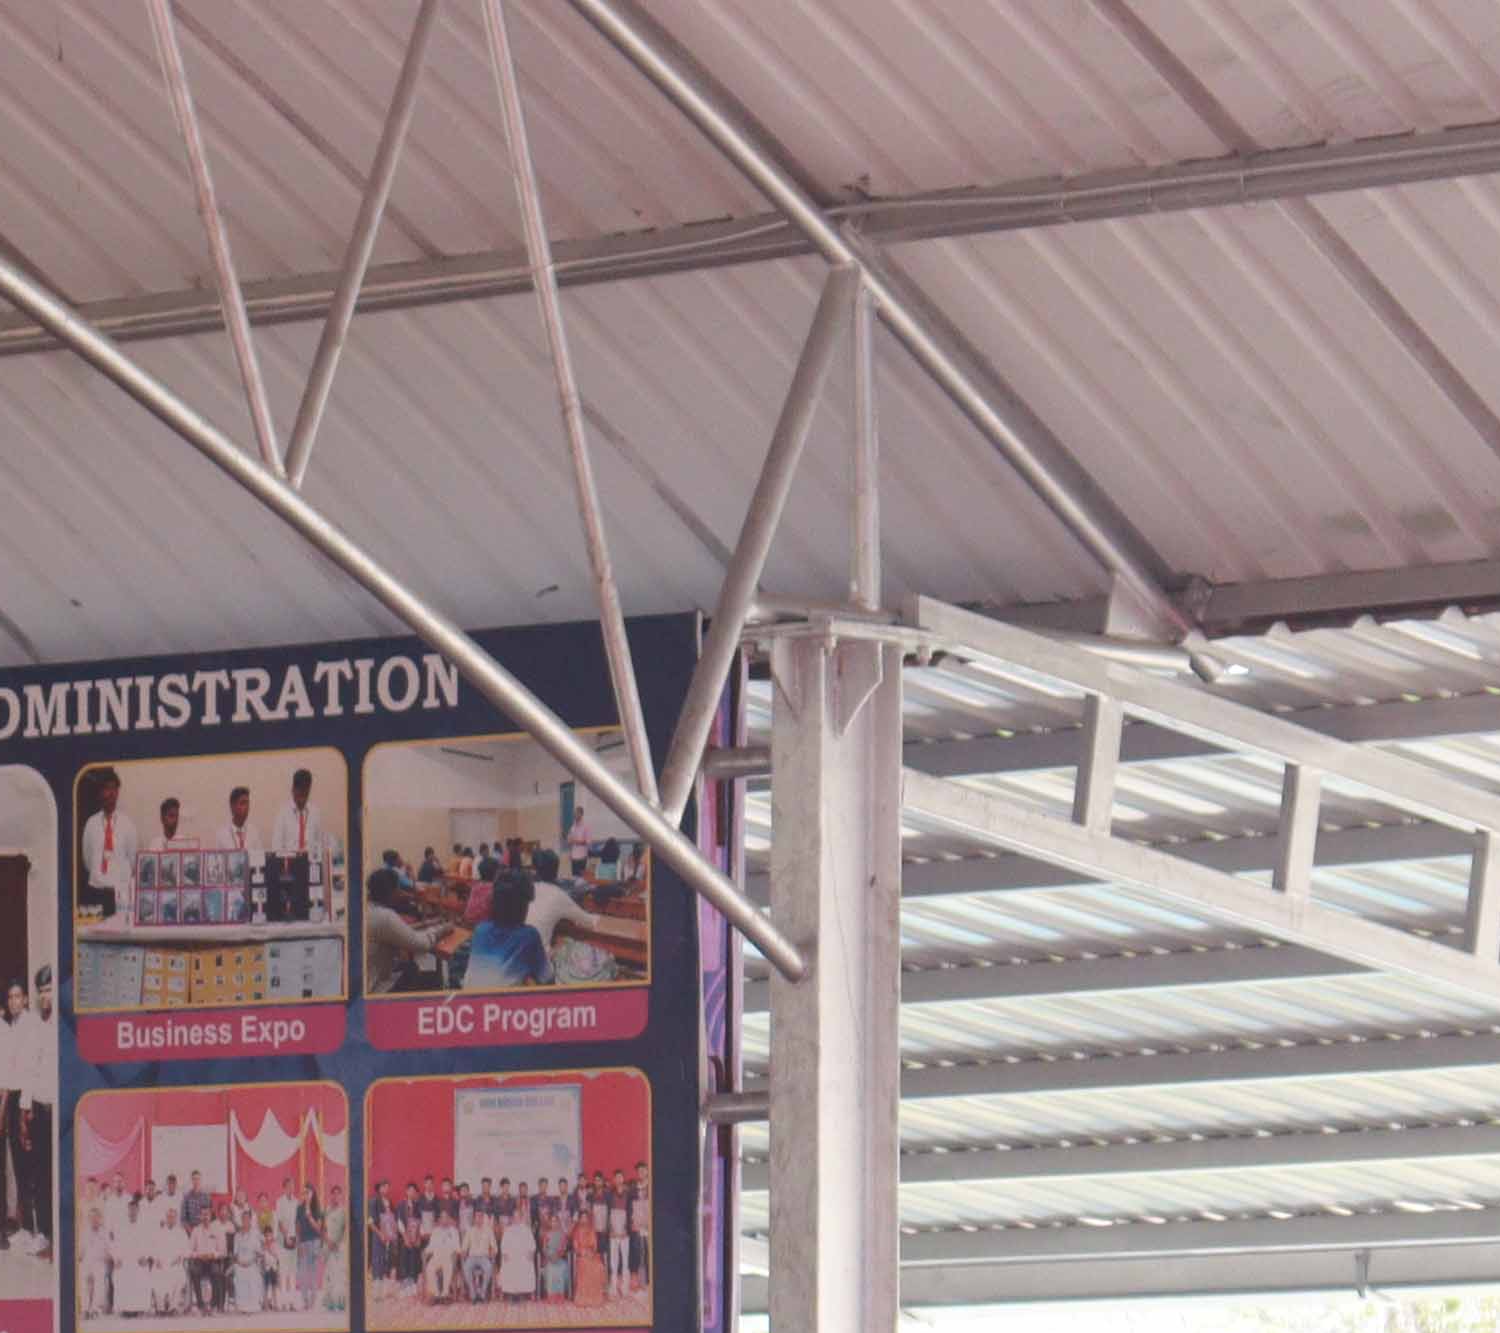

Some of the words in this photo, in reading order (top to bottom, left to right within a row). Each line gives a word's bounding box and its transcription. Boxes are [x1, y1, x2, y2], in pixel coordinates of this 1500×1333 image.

[116, 1020, 232, 1049] Business
[240, 1016, 306, 1049] Expo
[417, 1008, 476, 1035] EDC
[483, 1002, 596, 1038] Program
